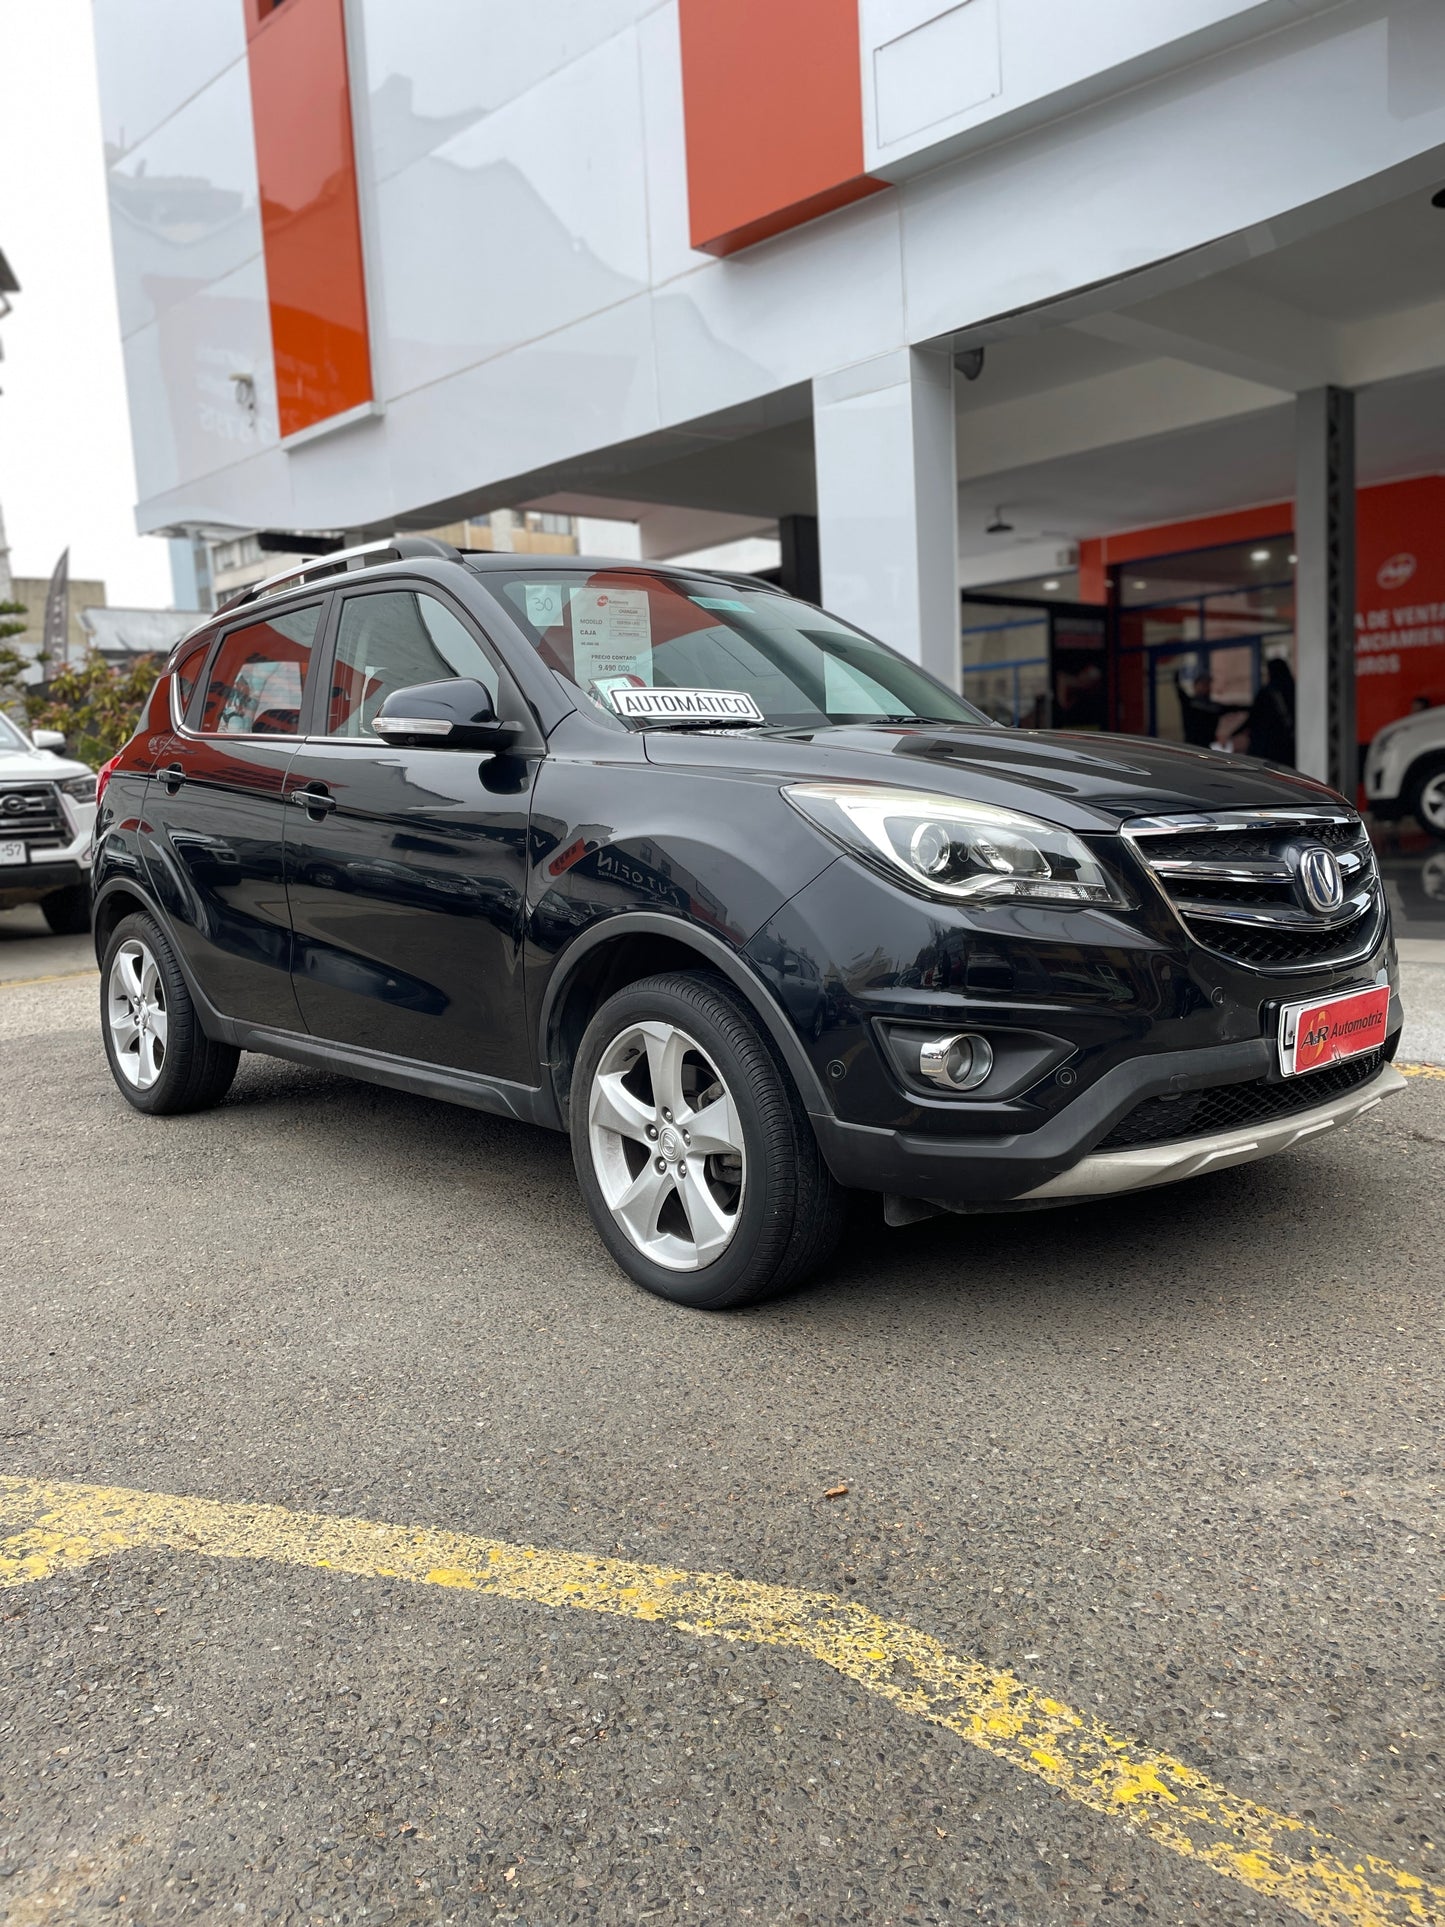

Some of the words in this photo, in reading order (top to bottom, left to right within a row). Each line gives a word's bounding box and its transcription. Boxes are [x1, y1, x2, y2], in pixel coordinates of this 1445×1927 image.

[532, 596, 553, 612] 30
[1367, 608, 1390, 630] DE
[625, 692, 750, 714] AUTOMÁTICO
[1330, 1009, 1383, 1039] Automotriz
